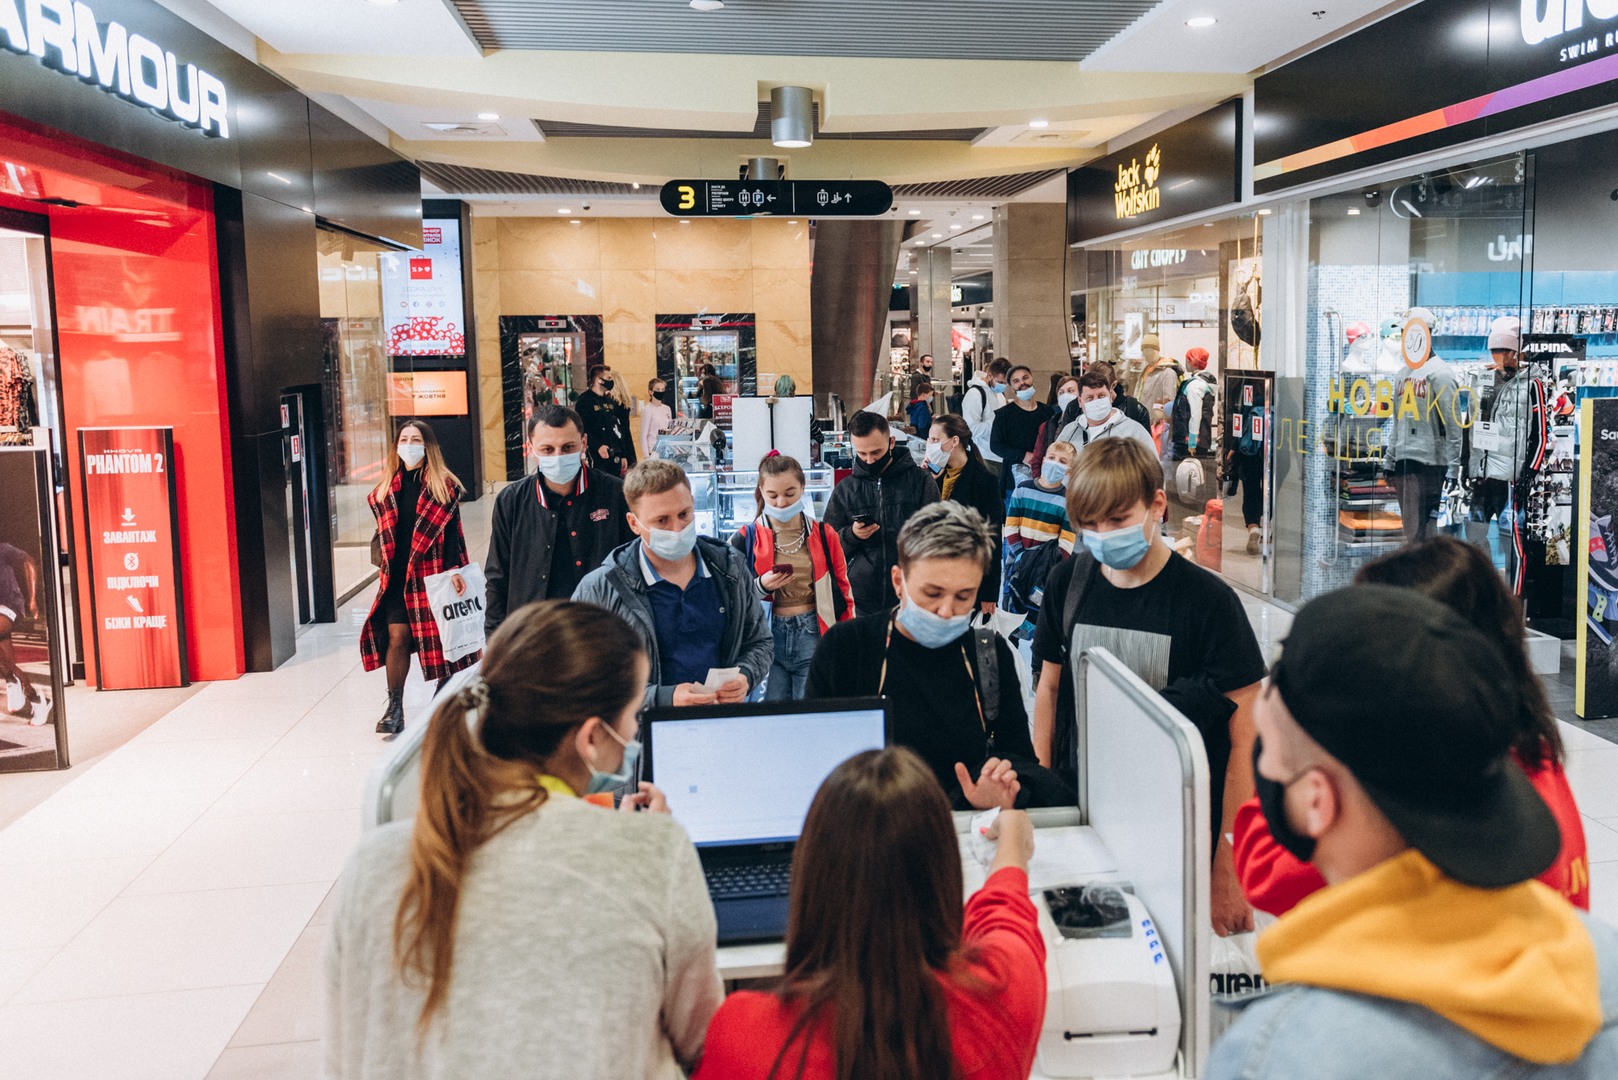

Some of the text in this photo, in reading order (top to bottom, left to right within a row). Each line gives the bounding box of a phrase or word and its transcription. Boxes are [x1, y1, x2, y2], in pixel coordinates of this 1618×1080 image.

[1559, 37, 1598, 62] SWIM
[1115, 158, 1140, 192] Jack
[678, 186, 695, 209] 3
[1115, 184, 1160, 219] Wolfskin
[87, 452, 164, 474] PHANTOM 2
[103, 530, 157, 544] ЗАВАНТАЖ
[107, 575, 159, 590] ПІДКЛЮЧИ
[105, 615, 167, 629] БІЖИ КРАЩЕ
